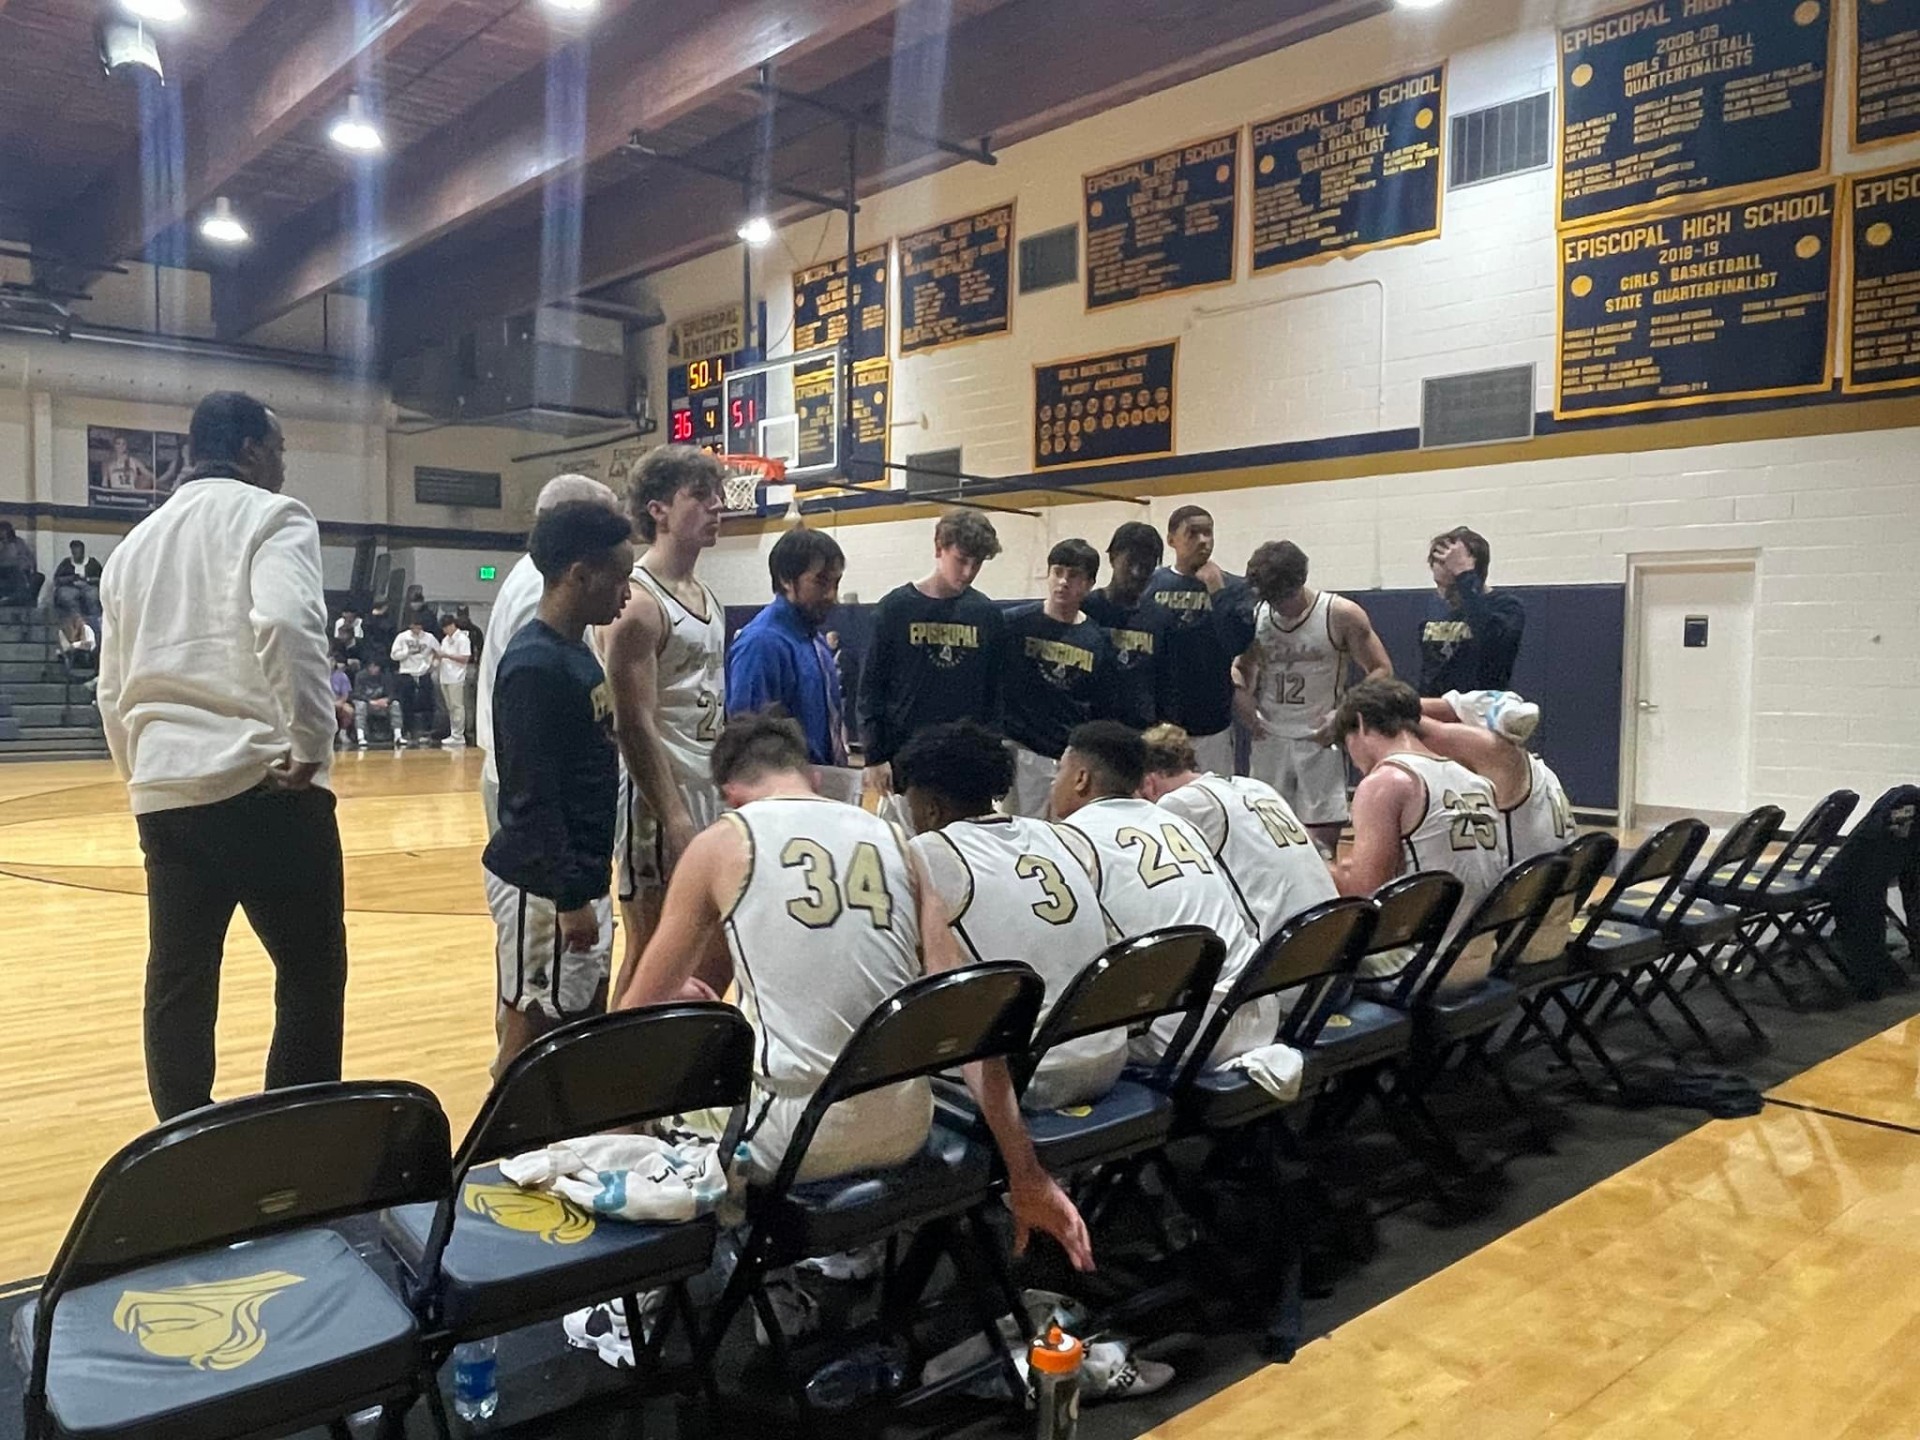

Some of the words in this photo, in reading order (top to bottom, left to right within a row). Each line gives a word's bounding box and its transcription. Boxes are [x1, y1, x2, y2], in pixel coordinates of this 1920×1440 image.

[1563, 4, 1671, 53] EPISCOPAL
[1683, 0, 1731, 17] HIG
[1623, 57, 1660, 81] GIRLS
[1668, 32, 1755, 67] BASKETBALL
[1625, 49, 1753, 97] QUARTERFINALISTS
[1338, 94, 1370, 120] HIGH
[1379, 75, 1440, 108] SCHOOL
[1565, 224, 1670, 263] EPISCOPAL
[1682, 211, 1731, 240] HIGH
[1744, 193, 1831, 229] SCHOOL
[1620, 271, 1659, 291] GIRLS
[1670, 253, 1762, 281] BASKETBALL
[1659, 240, 1720, 264] 2018-19
[1605, 293, 1643, 313] STATE
[1653, 272, 1778, 305] QUARTERFINALIST
[683, 328, 739, 358] KNIGHTS
[690, 359, 722, 389] 50.1
[674, 411, 692, 439] 36
[706, 410, 715, 428] 4
[733, 400, 754, 427] 51
[1275, 672, 1305, 704] 12
[1443, 789, 1497, 851] 25
[1115, 823, 1214, 889] 24
[780, 837, 892, 930] 34
[1015, 854, 1078, 925] 3
